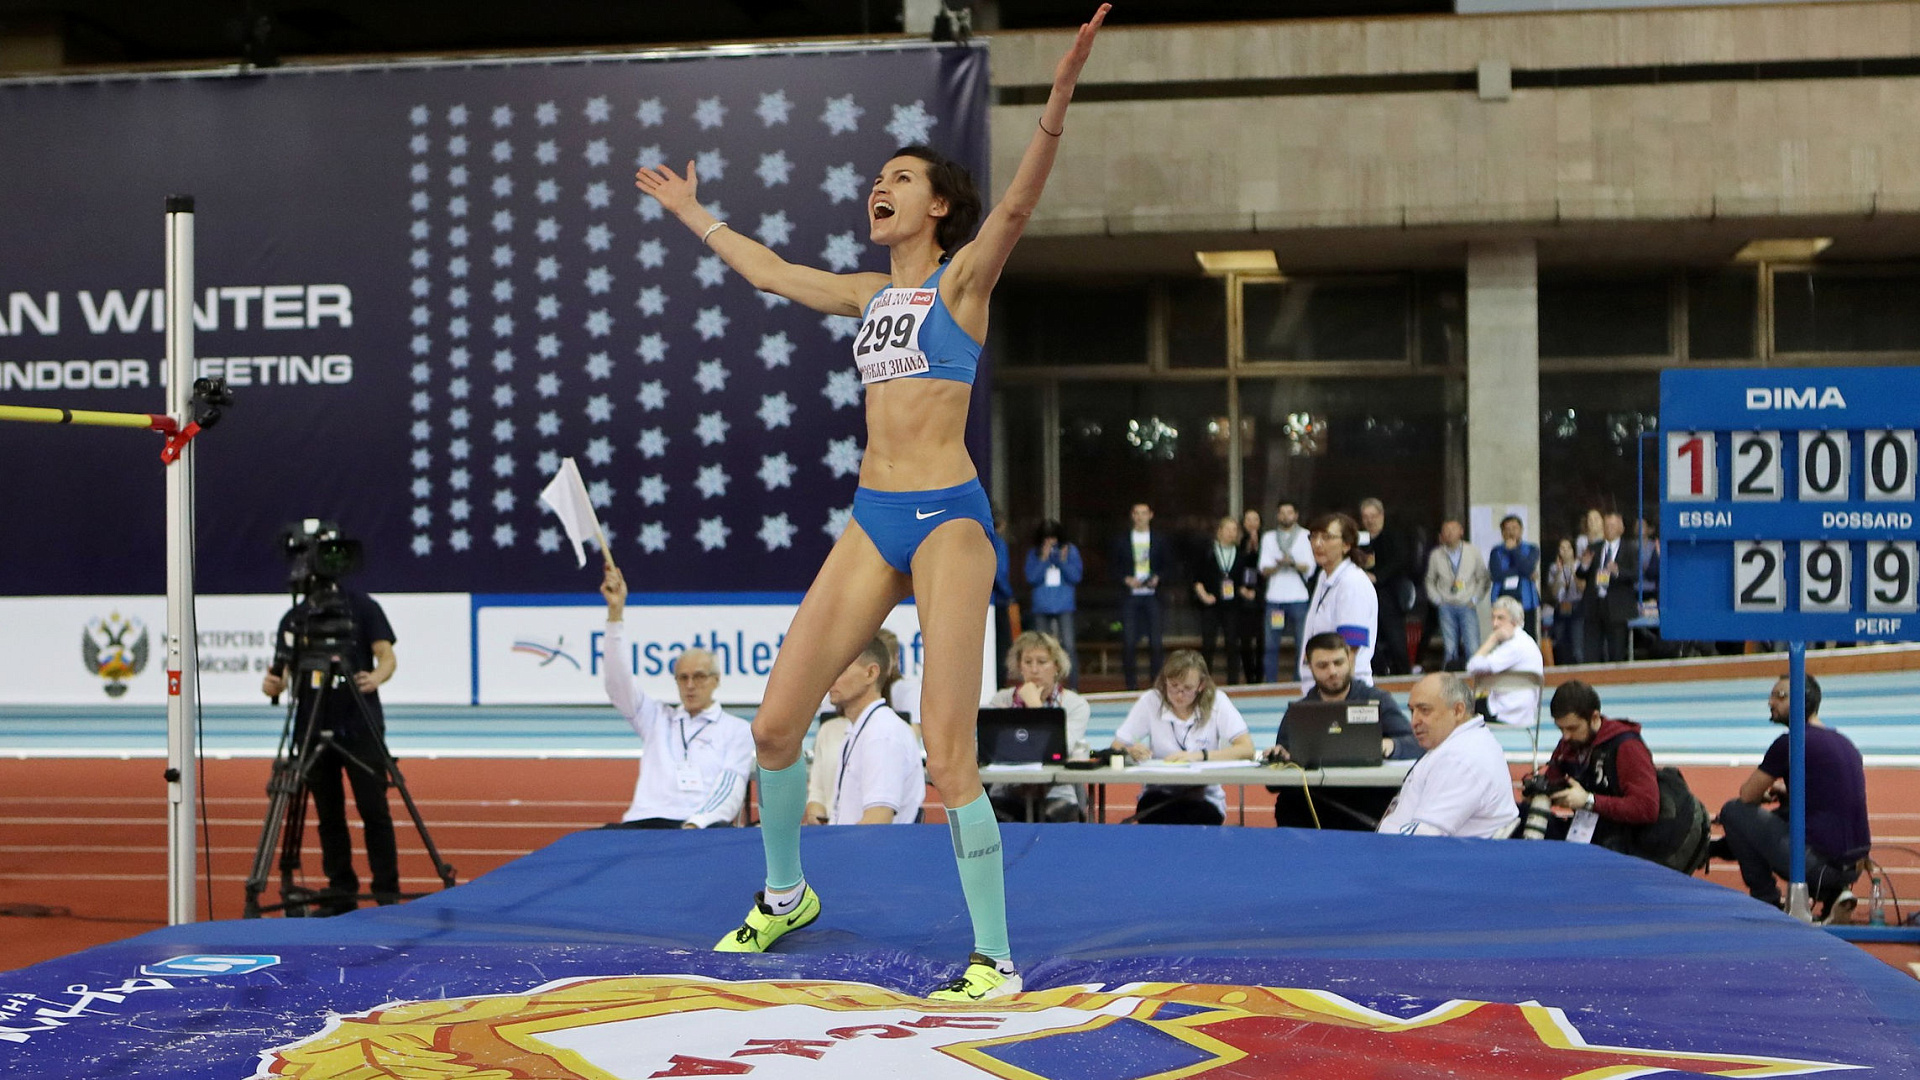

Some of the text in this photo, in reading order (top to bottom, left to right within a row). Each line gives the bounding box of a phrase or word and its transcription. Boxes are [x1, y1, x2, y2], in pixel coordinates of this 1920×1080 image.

[0, 291, 60, 336] N
[857, 313, 916, 356] 299
[0, 355, 354, 390] NDOOR EETING
[1746, 386, 1847, 410] DIMA
[1679, 511, 1913, 530] ESSAI DOSSARD
[1855, 618, 1902, 635] PERF
